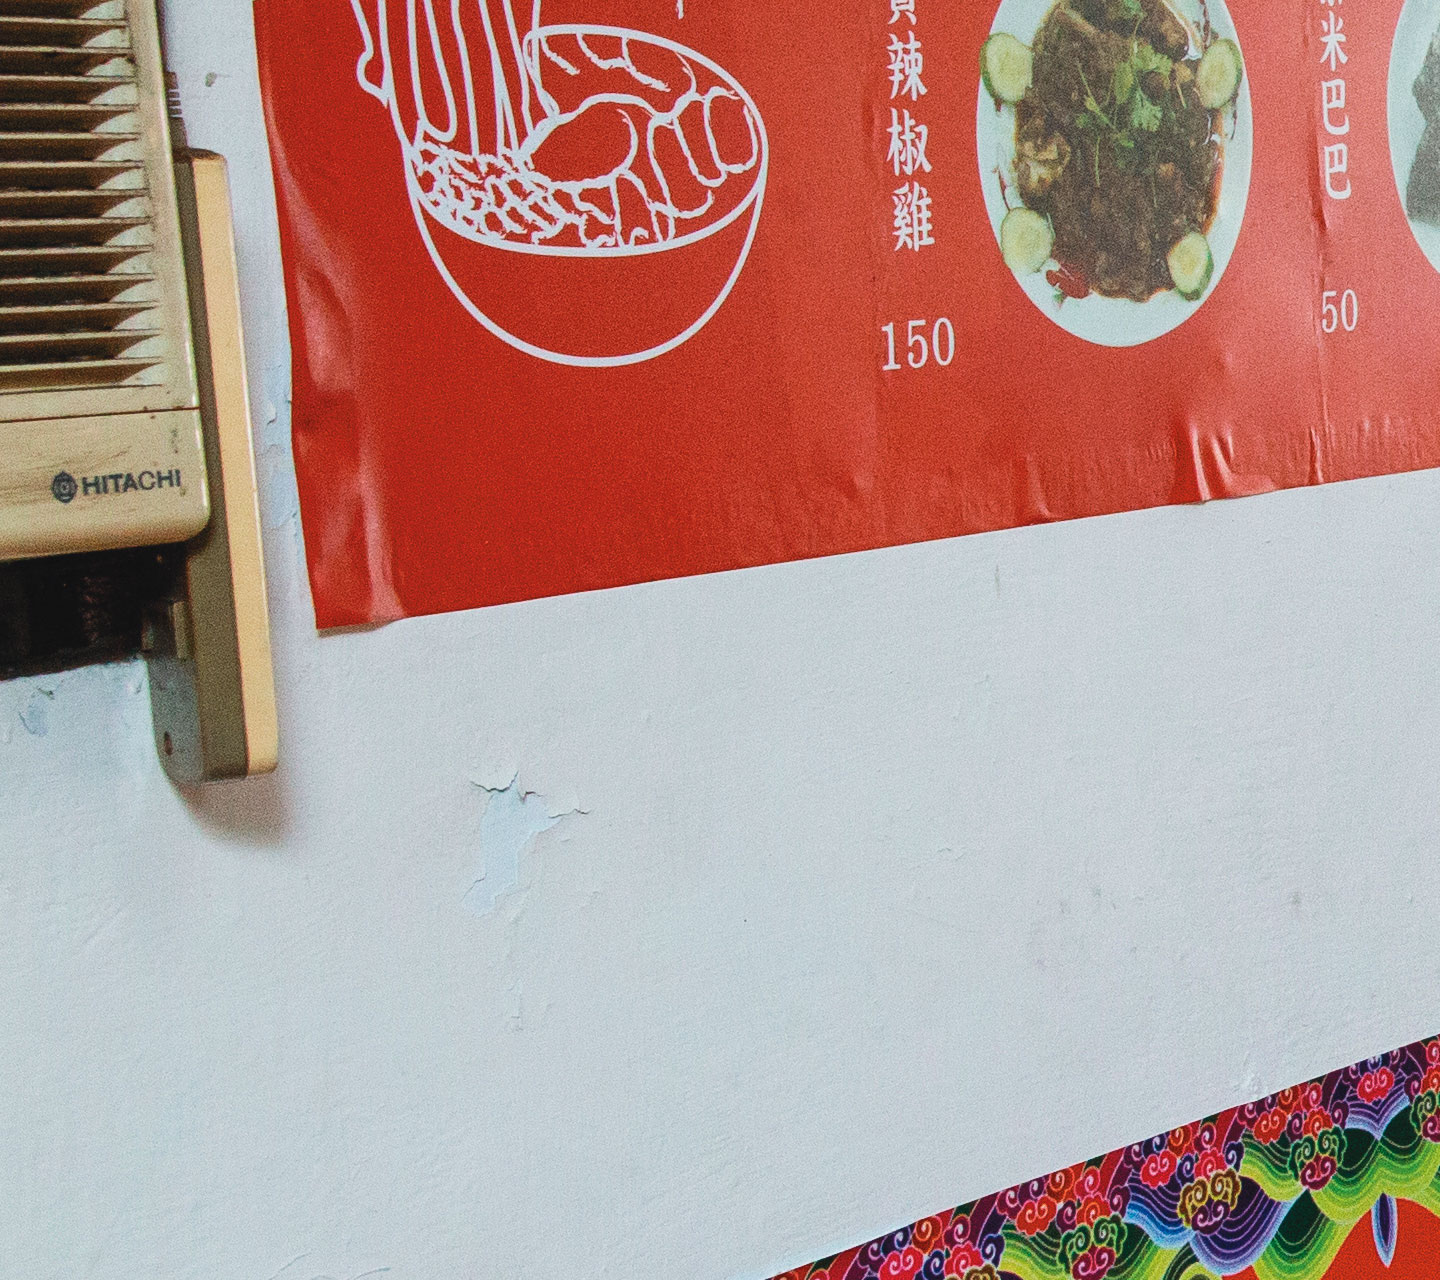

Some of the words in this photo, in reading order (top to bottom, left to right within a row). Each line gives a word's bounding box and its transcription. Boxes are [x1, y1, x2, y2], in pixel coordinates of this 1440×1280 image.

[1321, 289, 1359, 333] 50
[881, 317, 957, 372] 150
[82, 468, 182, 497] HITACHI
